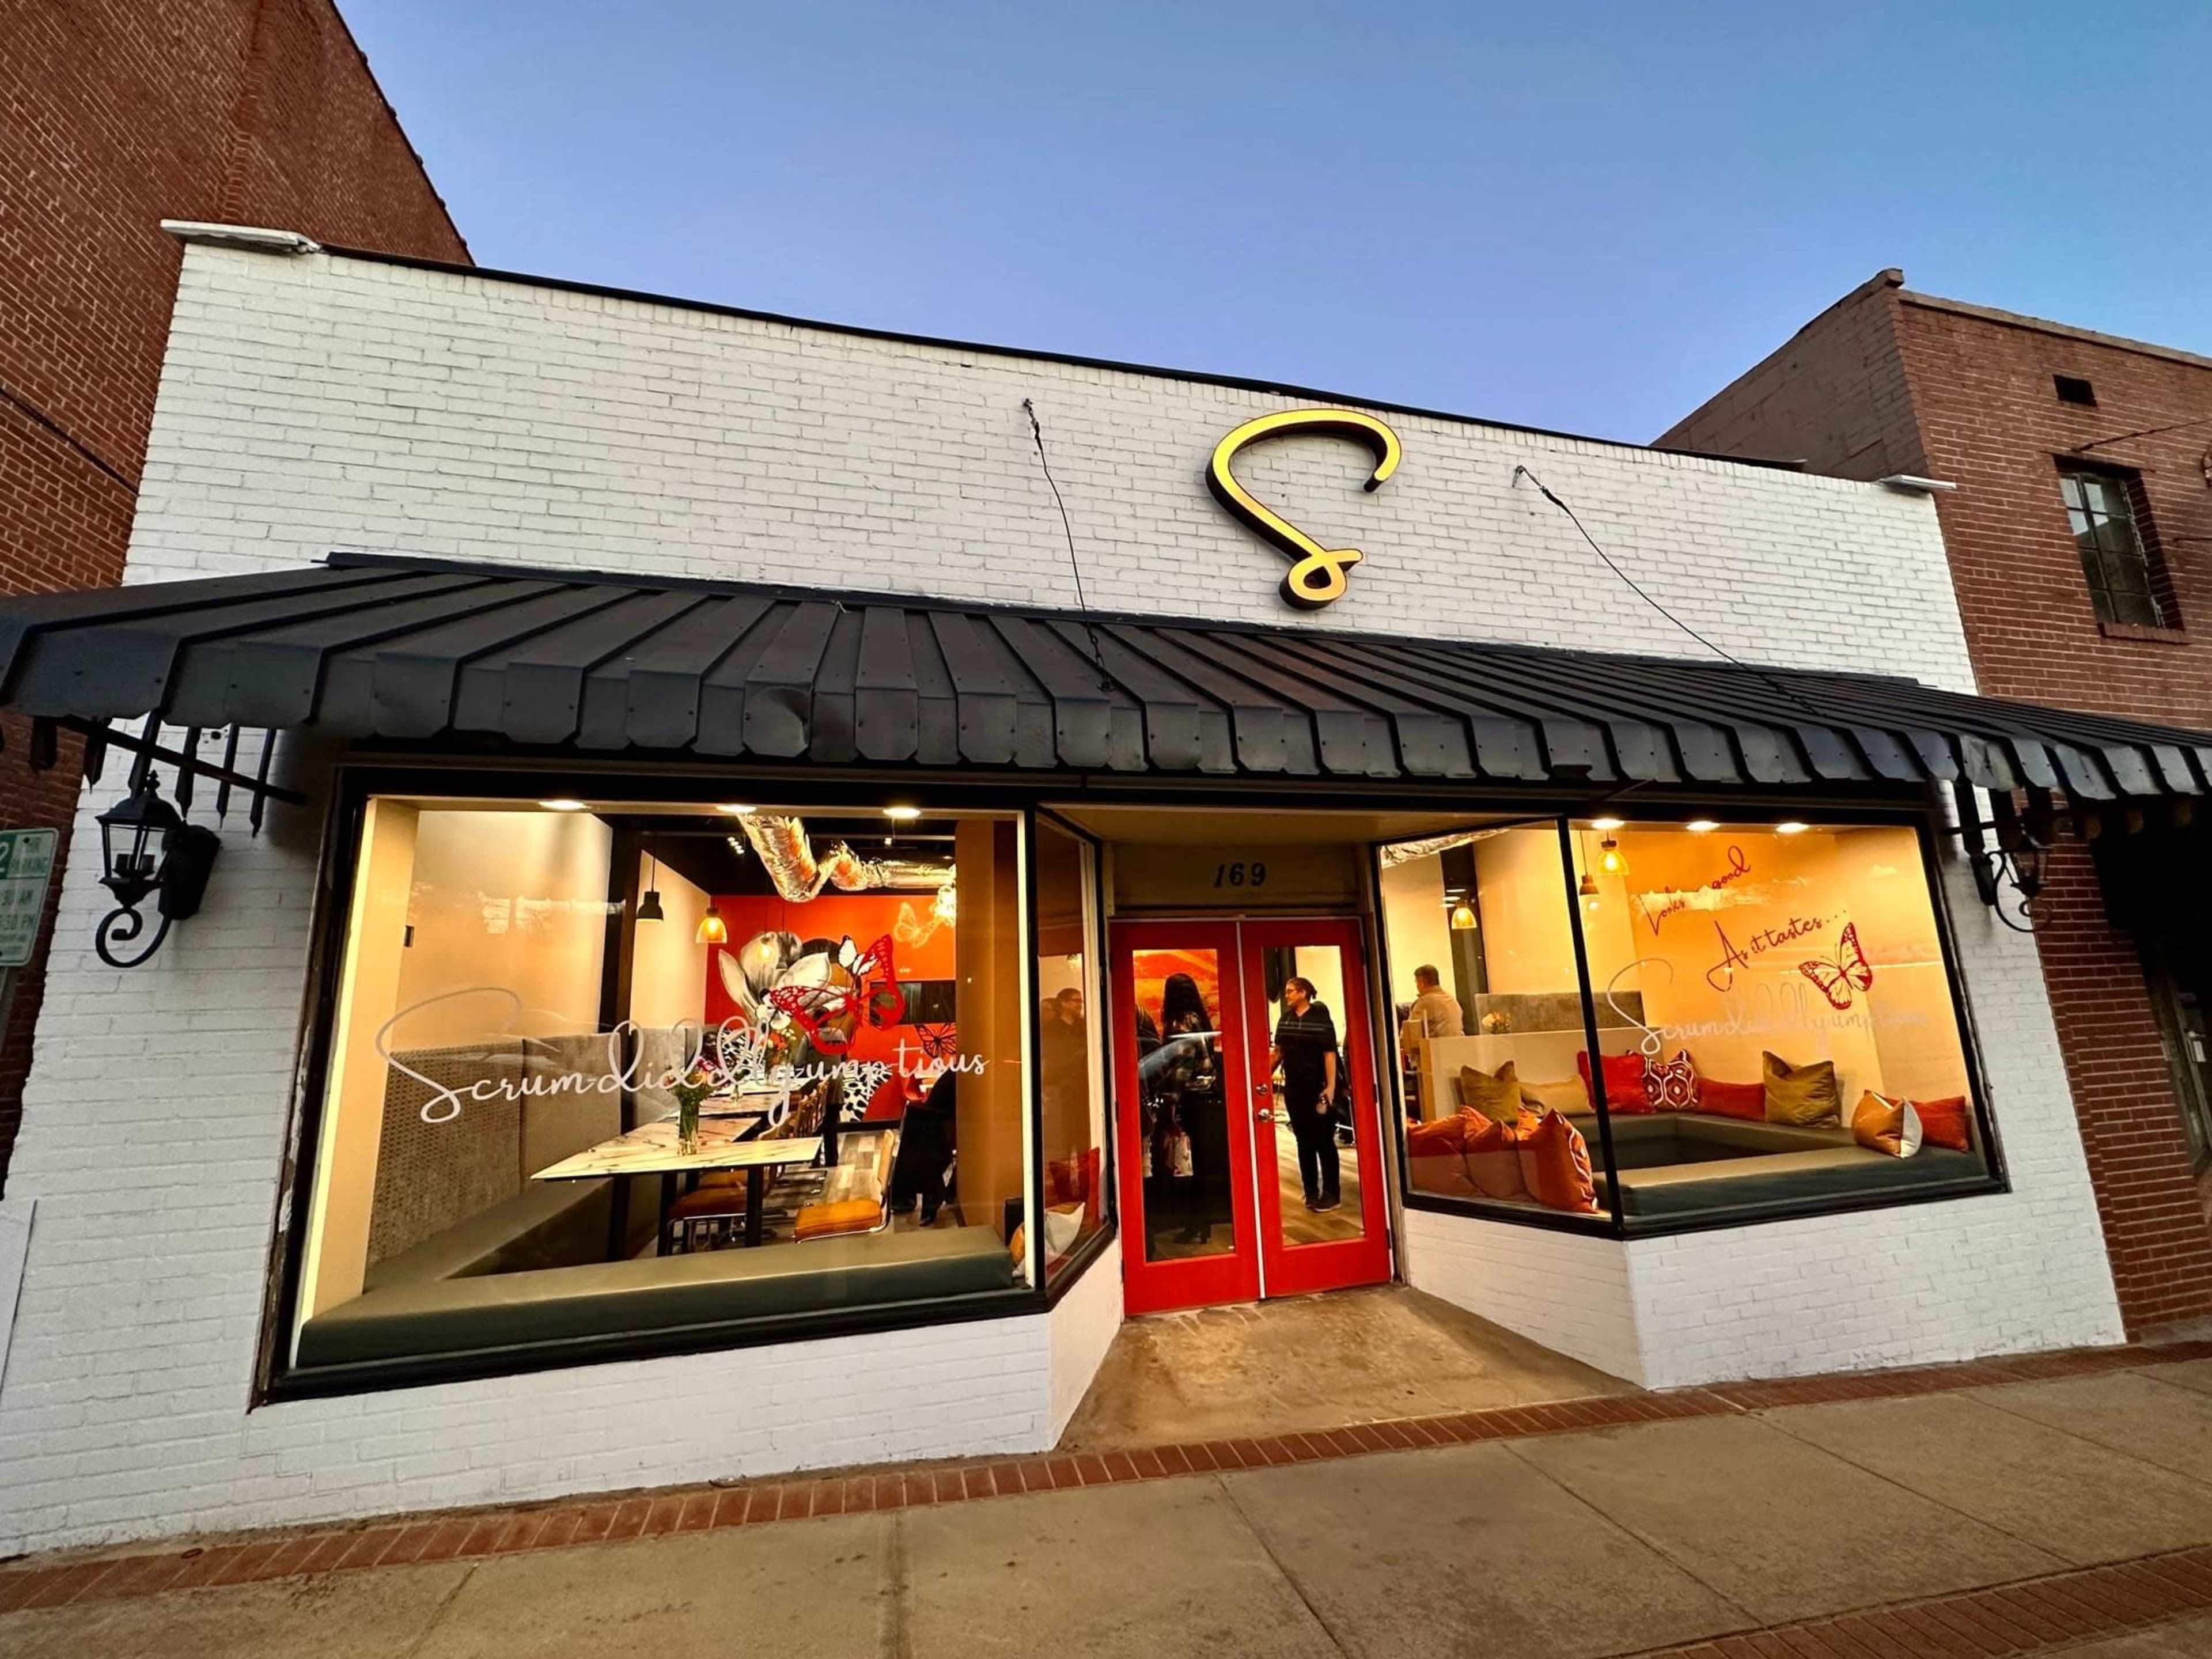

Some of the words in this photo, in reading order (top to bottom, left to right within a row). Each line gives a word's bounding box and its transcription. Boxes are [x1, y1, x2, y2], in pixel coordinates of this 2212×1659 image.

[1205, 408, 1402, 611] S
[1213, 862, 1266, 888] 169
[1707, 920, 1749, 992] As
[1750, 935, 1766, 953] it
